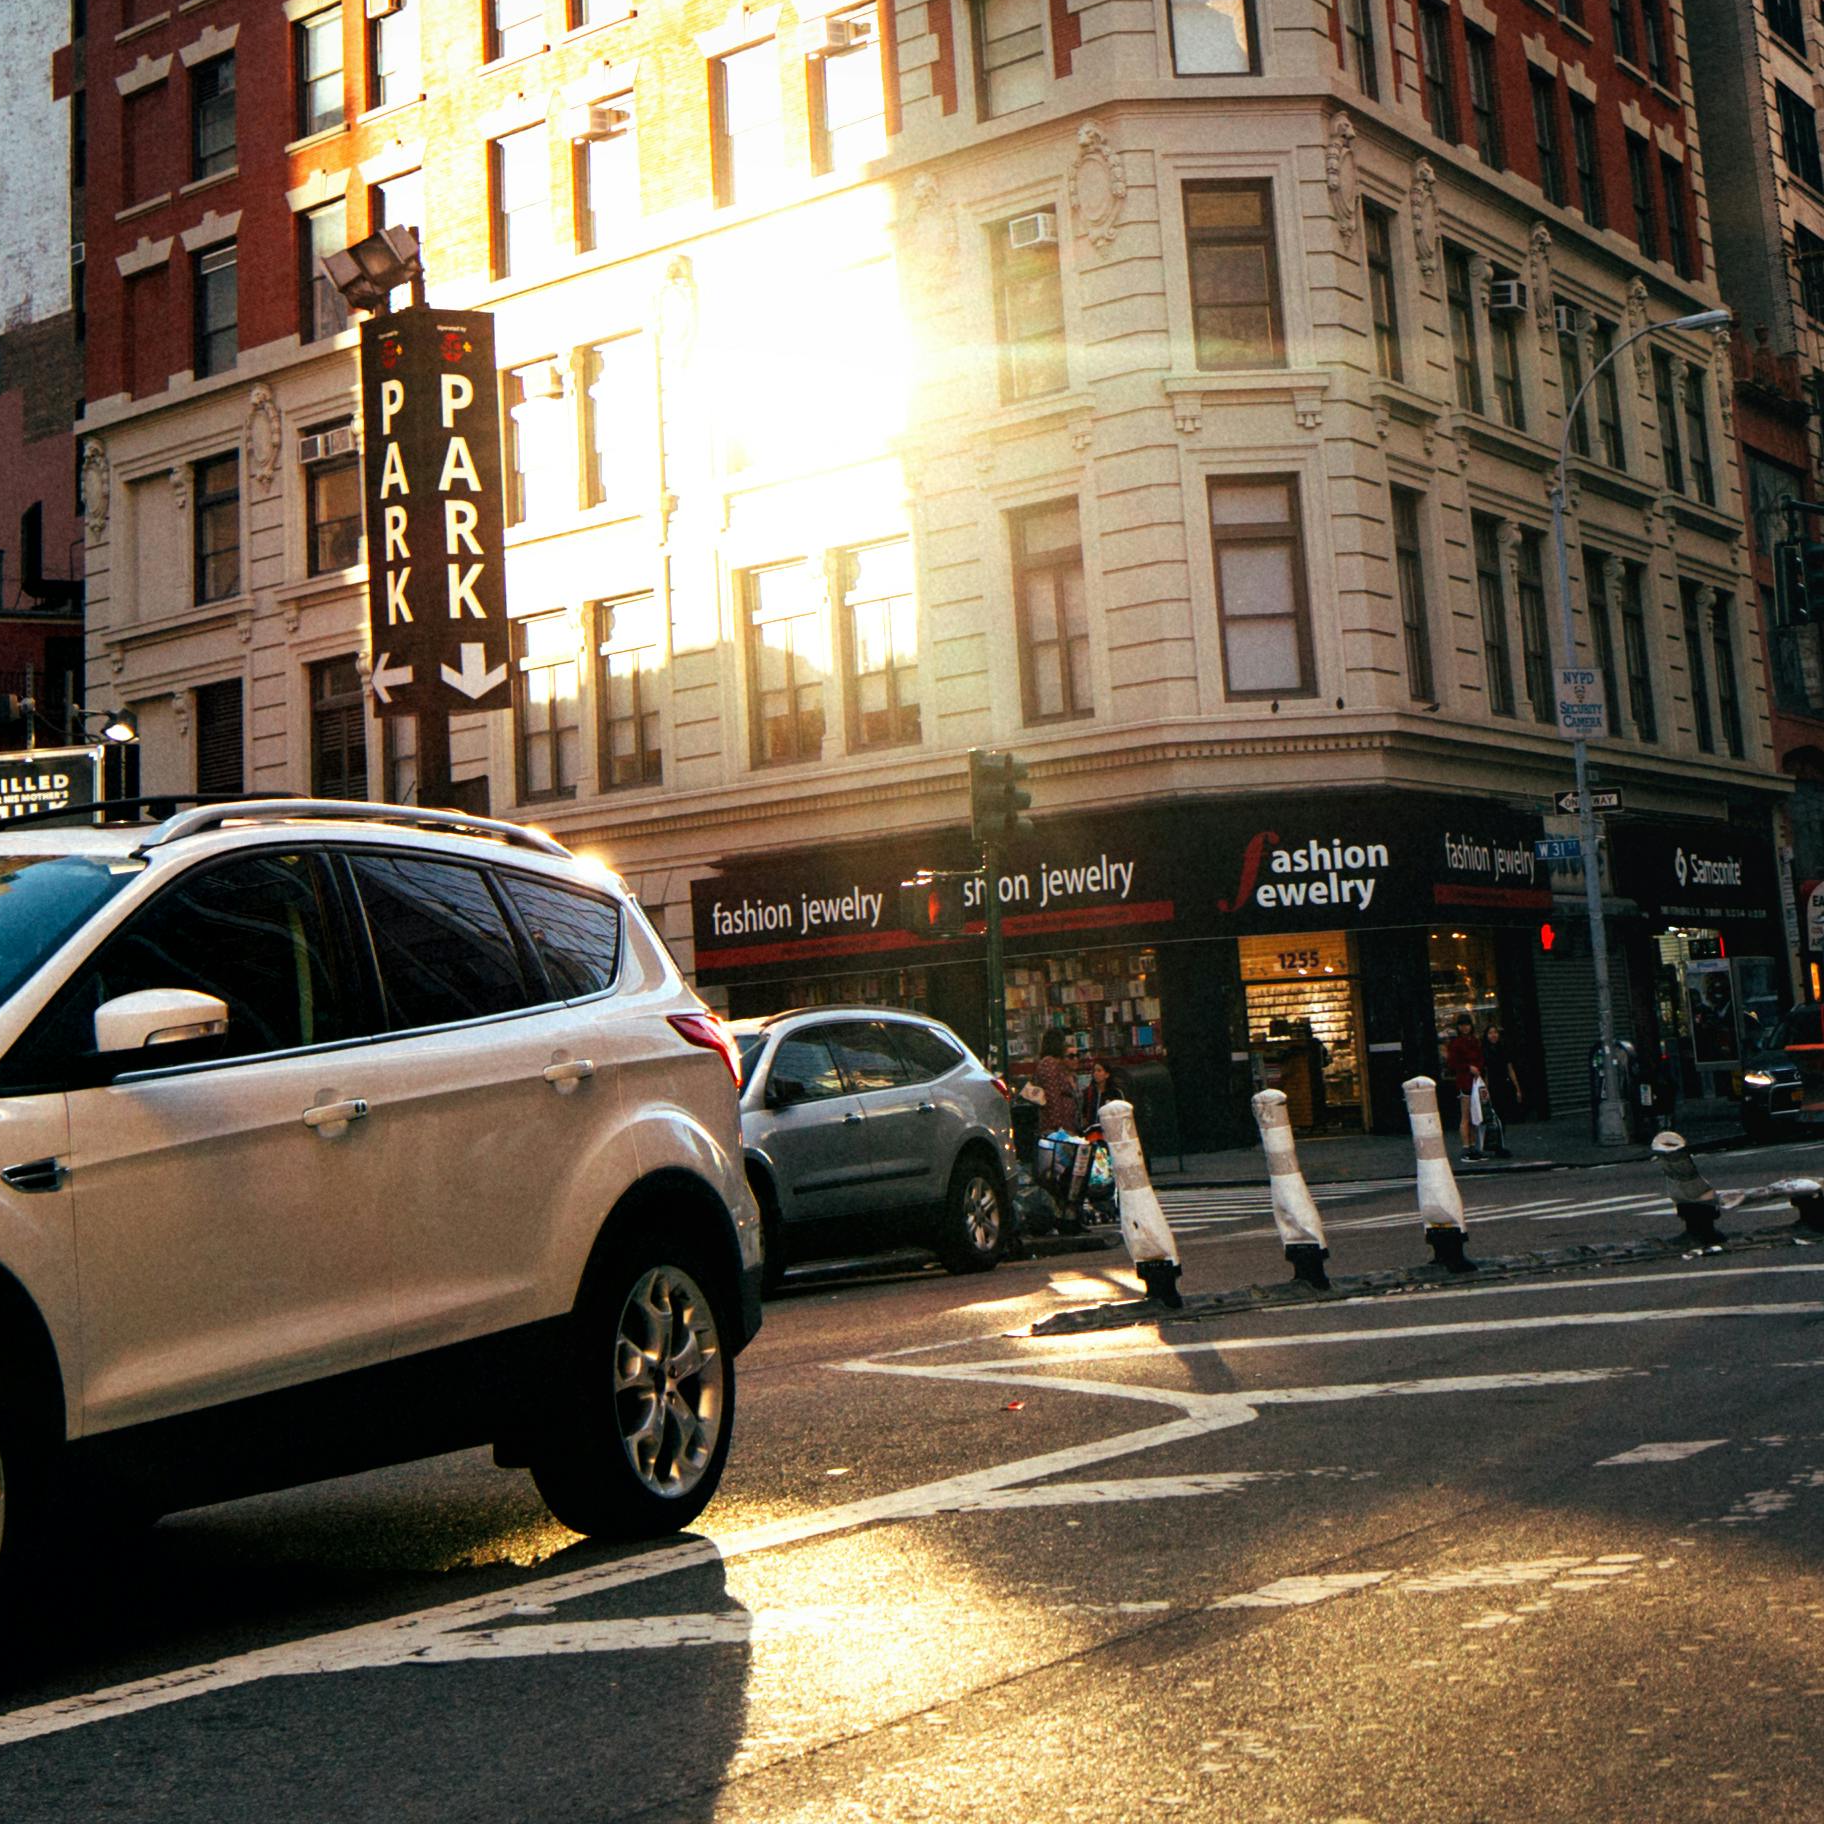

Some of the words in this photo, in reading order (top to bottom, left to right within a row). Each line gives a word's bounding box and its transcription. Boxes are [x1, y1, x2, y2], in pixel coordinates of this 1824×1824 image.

[380, 379, 414, 625] PARK
[438, 373, 488, 619] PARK
[1562, 671, 1594, 685] NYPD
[1559, 701, 1603, 715] SECURITY
[1562, 715, 1602, 728] CAMERA
[3, 793, 20, 803] HIS
[20, 790, 69, 802] MOTHER'S
[1565, 797, 1578, 808] ON
[1445, 831, 1491, 871] fashion
[1492, 839, 1535, 885] jewelry
[1538, 843, 1548, 857] W
[1552, 842, 1565, 856] 31
[1690, 853, 1742, 886] Samsonite
[964, 874, 1030, 907] shon
[1039, 854, 1134, 908] jewelry
[712, 898, 792, 936] fashion
[800, 885, 883, 935] jewelry
[1277, 951, 1320, 969] 1255
